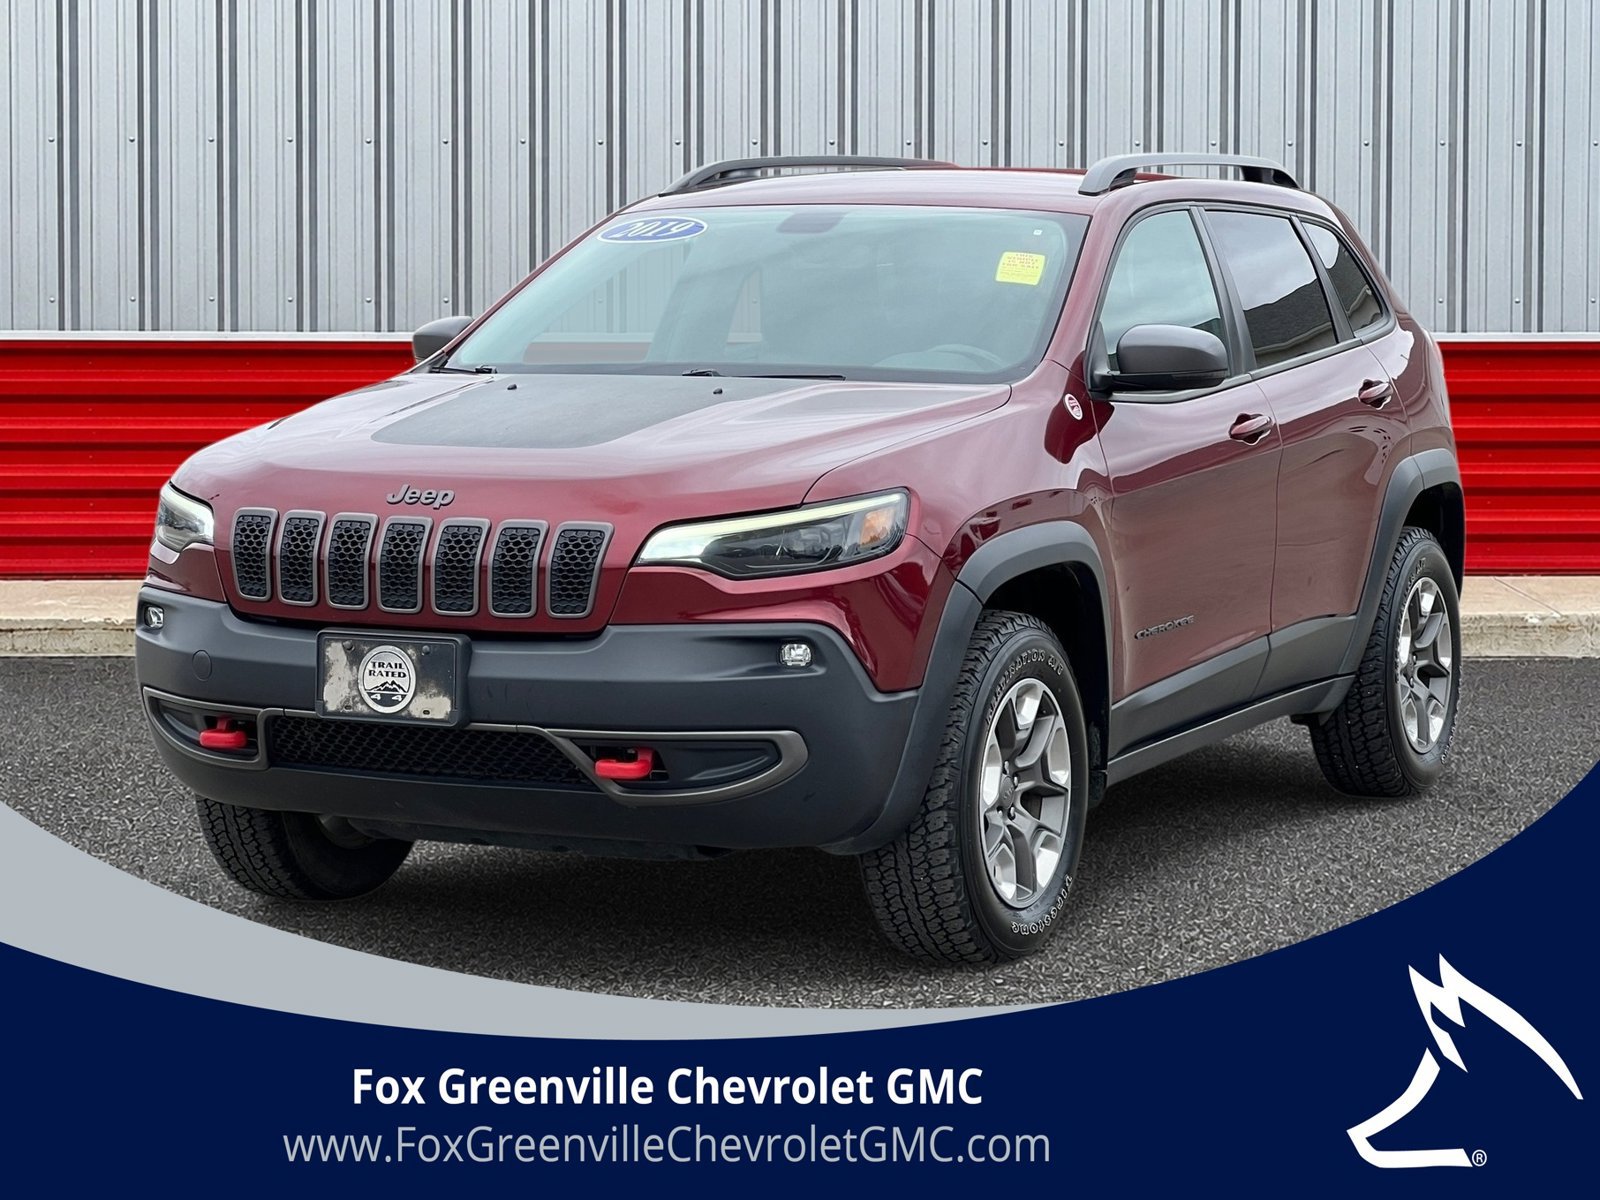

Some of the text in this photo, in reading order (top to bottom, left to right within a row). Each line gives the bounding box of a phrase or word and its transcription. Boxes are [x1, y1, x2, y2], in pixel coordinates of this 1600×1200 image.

[607, 221, 696, 239] 2019
[386, 484, 455, 510] Jeep
[1134, 615, 1195, 640] CHEROKEE
[368, 669, 407, 678] RATED
[370, 661, 405, 670] TRAIL
[1010, 873, 1074, 936] Firestone
